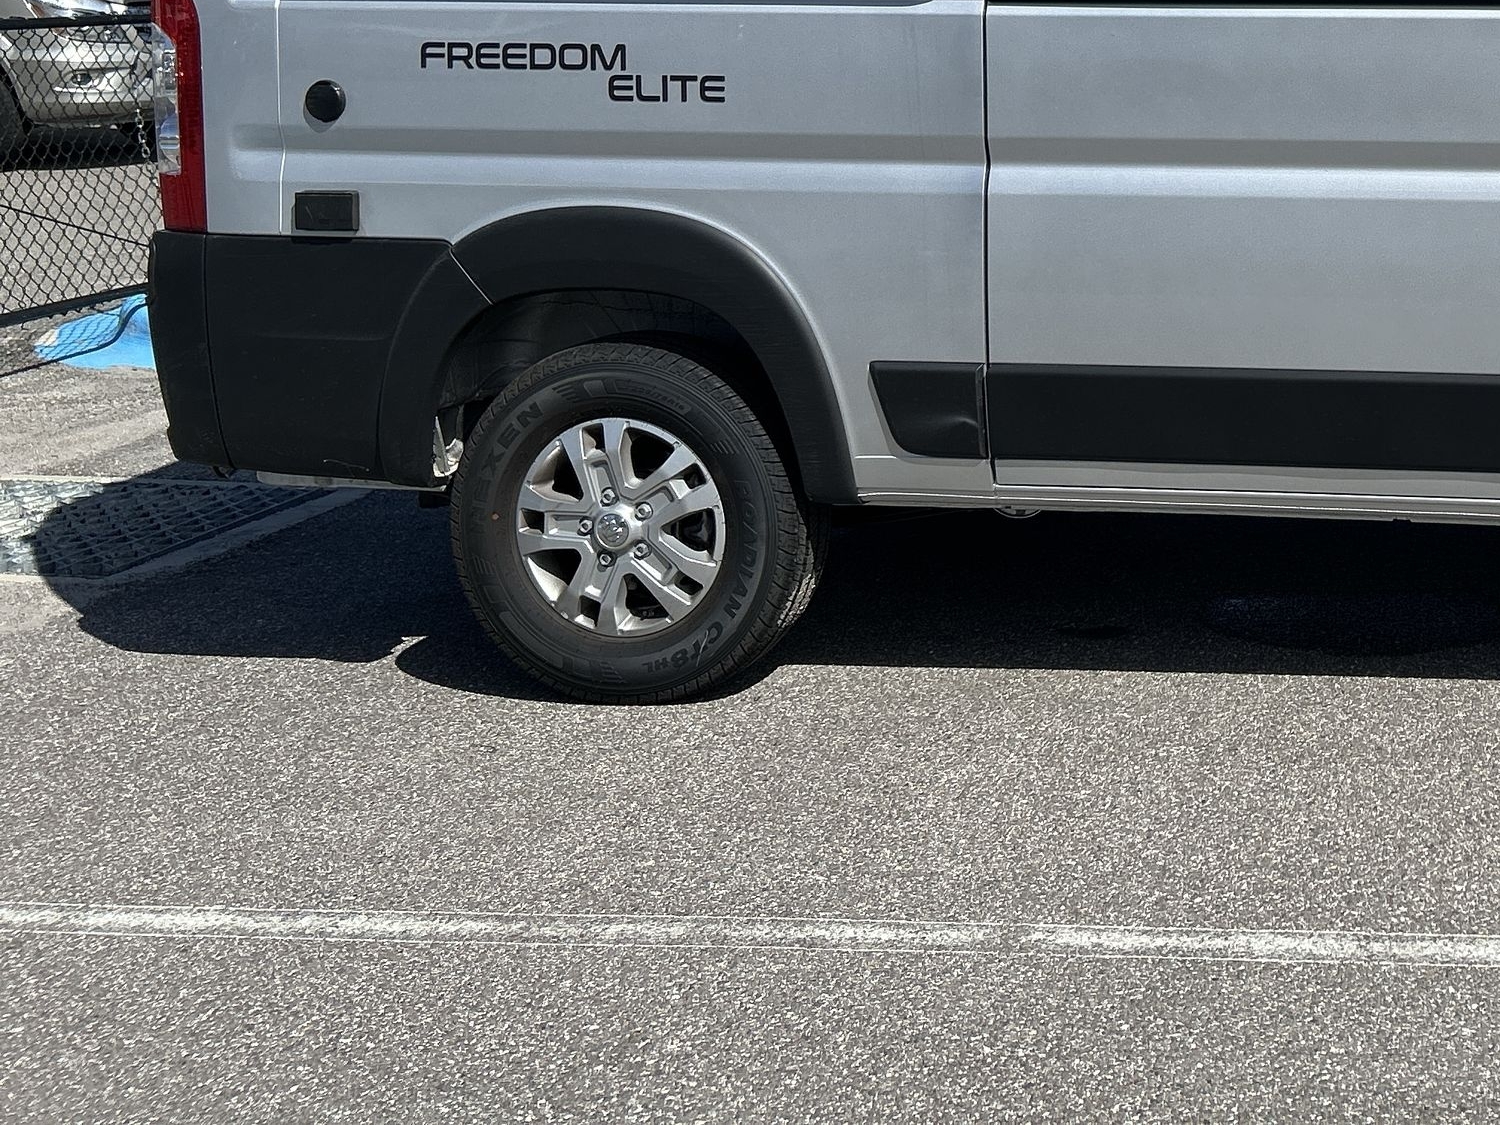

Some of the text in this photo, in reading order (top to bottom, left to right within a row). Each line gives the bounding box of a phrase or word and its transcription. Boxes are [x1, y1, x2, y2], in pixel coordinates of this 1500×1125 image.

[420, 41, 627, 71] FREEDOM
[608, 74, 726, 103] ELITE
[472, 400, 545, 534] NEXEN
